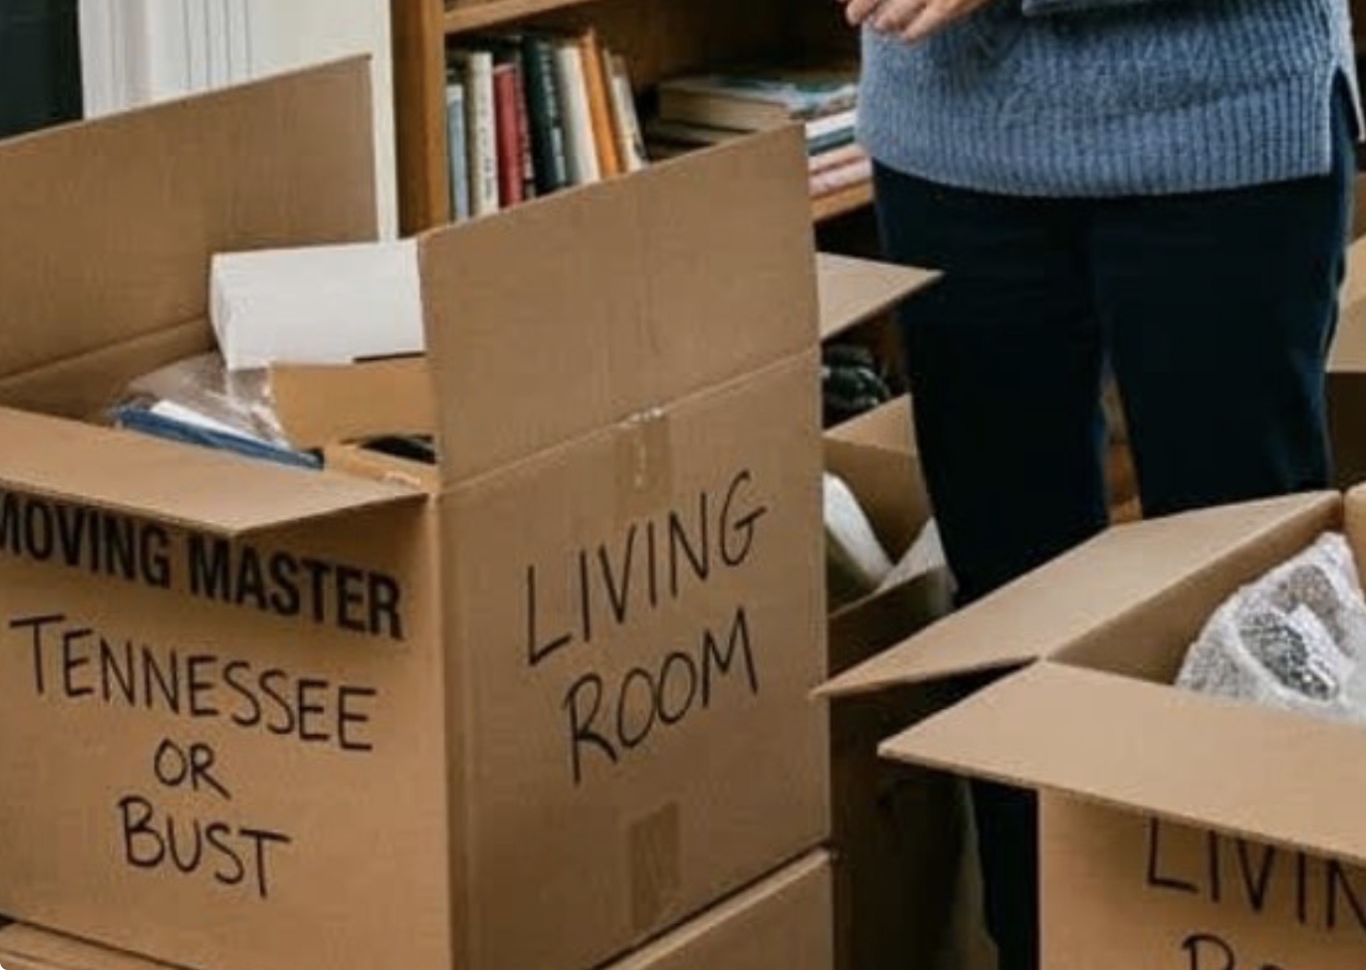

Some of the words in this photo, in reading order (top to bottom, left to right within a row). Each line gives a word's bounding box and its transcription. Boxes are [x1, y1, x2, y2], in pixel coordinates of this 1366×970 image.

[187, 532, 405, 641] MASTER
[526, 468, 768, 668] LIVING
[9, 614, 377, 752] TENNESSEE
[562, 604, 758, 786] ROOM
[153, 738, 232, 800] OR
[117, 795, 292, 898] BUST
